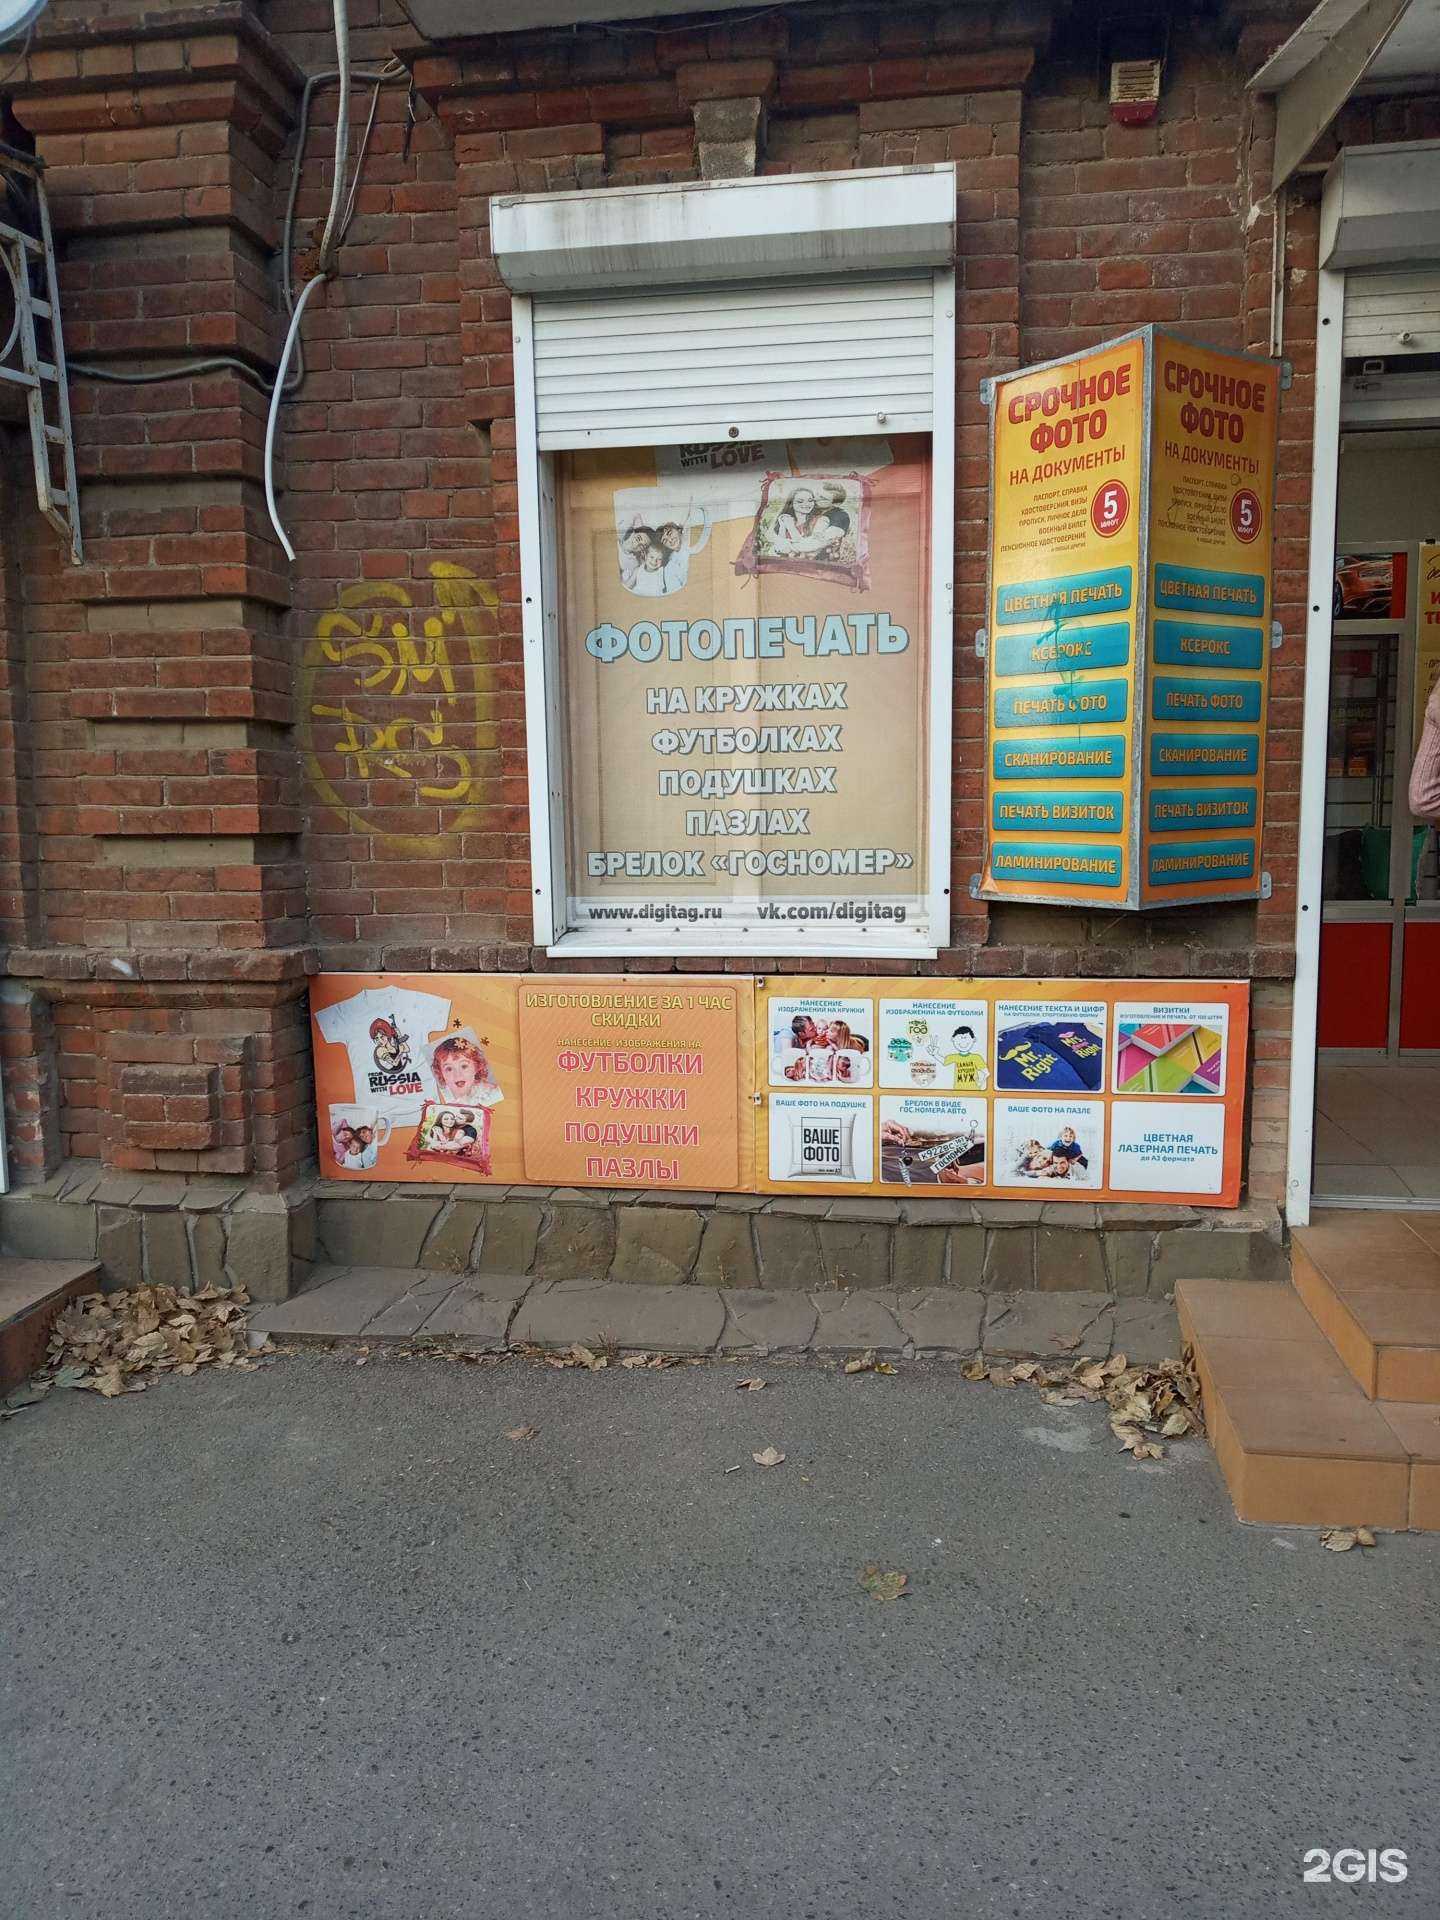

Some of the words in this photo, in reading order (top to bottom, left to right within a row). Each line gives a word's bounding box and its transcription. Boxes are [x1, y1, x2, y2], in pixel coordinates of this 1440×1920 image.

[1008, 364, 1131, 424] СРОЧНОЕ
[1164, 360, 1266, 413] СРОЧНОЕ
[1031, 409, 1107, 453] ФОТО
[1180, 402, 1244, 443] ФОТО
[680, 455, 707, 467] WITH
[711, 444, 765, 469] LOVE
[1010, 470, 1029, 486] НА
[1032, 444, 1126, 484] ДОКУМЕНТЫ
[1165, 441, 1180, 458] НА
[1182, 445, 1259, 474] ДОКУМЕНТЫ
[1103, 490, 1118, 519] 5
[1240, 499, 1253, 526] 5
[1070, 584, 1123, 605] ПЕЧАТЬ
[1160, 579, 1210, 599] ЦВЕТНАЯ
[1212, 586, 1257, 604] ПЕЧАТЬ
[585, 612, 910, 663] ФОТОПЕЧАТЬ
[1180, 638, 1230, 655] КСЕРОКС
[646, 689, 689, 714] НА
[695, 682, 848, 713] КРУЖКАХ
[1013, 698, 1065, 716] ПЕЧАТЬ
[1166, 692, 1208, 708] ПЕЧАТЬ
[1210, 694, 1244, 709] ФОТО
[651, 725, 842, 755] ФУТБОЛКАХ
[1004, 750, 1112, 767] СКАНИРОВАНИЕ
[1159, 748, 1248, 763] СКАНИРОВАНИЕ
[658, 767, 837, 799] ПОДУШКАХ
[999, 804, 1049, 819] ПЕЧАТЬ
[1052, 804, 1115, 820] ВИЗИТОК
[1154, 803, 1195, 818] ПЕЧАТЬ
[1196, 802, 1249, 817] ВИЗИТОК
[686, 809, 811, 837] ПАЗЛАХ
[587, 851, 706, 877] БРЕЛОК
[711, 848, 913, 876] «ГОСНОМЕР»
[994, 855, 1116, 873] ЛАМИНИРОВАНИЕ
[1151, 852, 1249, 873] ЛАМИНИРОВАНИЕ
[589, 903, 722, 923] www.digitag.ru
[757, 901, 906, 924] vk.com/digitag
[525, 993, 657, 1009] ИЗГОТОВЛЕНИЕ
[662, 995, 683, 1009] ЗА
[687, 996, 694, 1009] 1
[698, 996, 732, 1010] ЧАС
[591, 1012, 662, 1029] СКИДКИ
[615, 1040, 686, 1048] ИЗОБРАЖЕНИЯ
[688, 1040, 702, 1048] НА
[558, 1050, 704, 1074] ФУТБОЛКИ
[1014, 1051, 1042, 1067] Mr.
[1021, 1054, 1058, 1081] Right
[369, 1071, 421, 1087] RUSSIA
[957, 1074, 975, 1082] МУЖ
[389, 1083, 423, 1096] LOVE
[575, 1087, 688, 1110] КРУЖКИ
[831, 1101, 866, 1109] ПОДУШКЕ
[565, 1122, 700, 1147] ПОДУШКИ
[803, 1128, 840, 1145] ВАШЕ
[1143, 1133, 1193, 1143] ЦВЕТНАЯ
[803, 1146, 840, 1162] ФОТО
[1118, 1144, 1174, 1153] ЛАЗЕРНАЯ
[1177, 1145, 1218, 1155] ПЕЧАТЬ
[586, 1157, 679, 1180] ПАЗЛЫ
